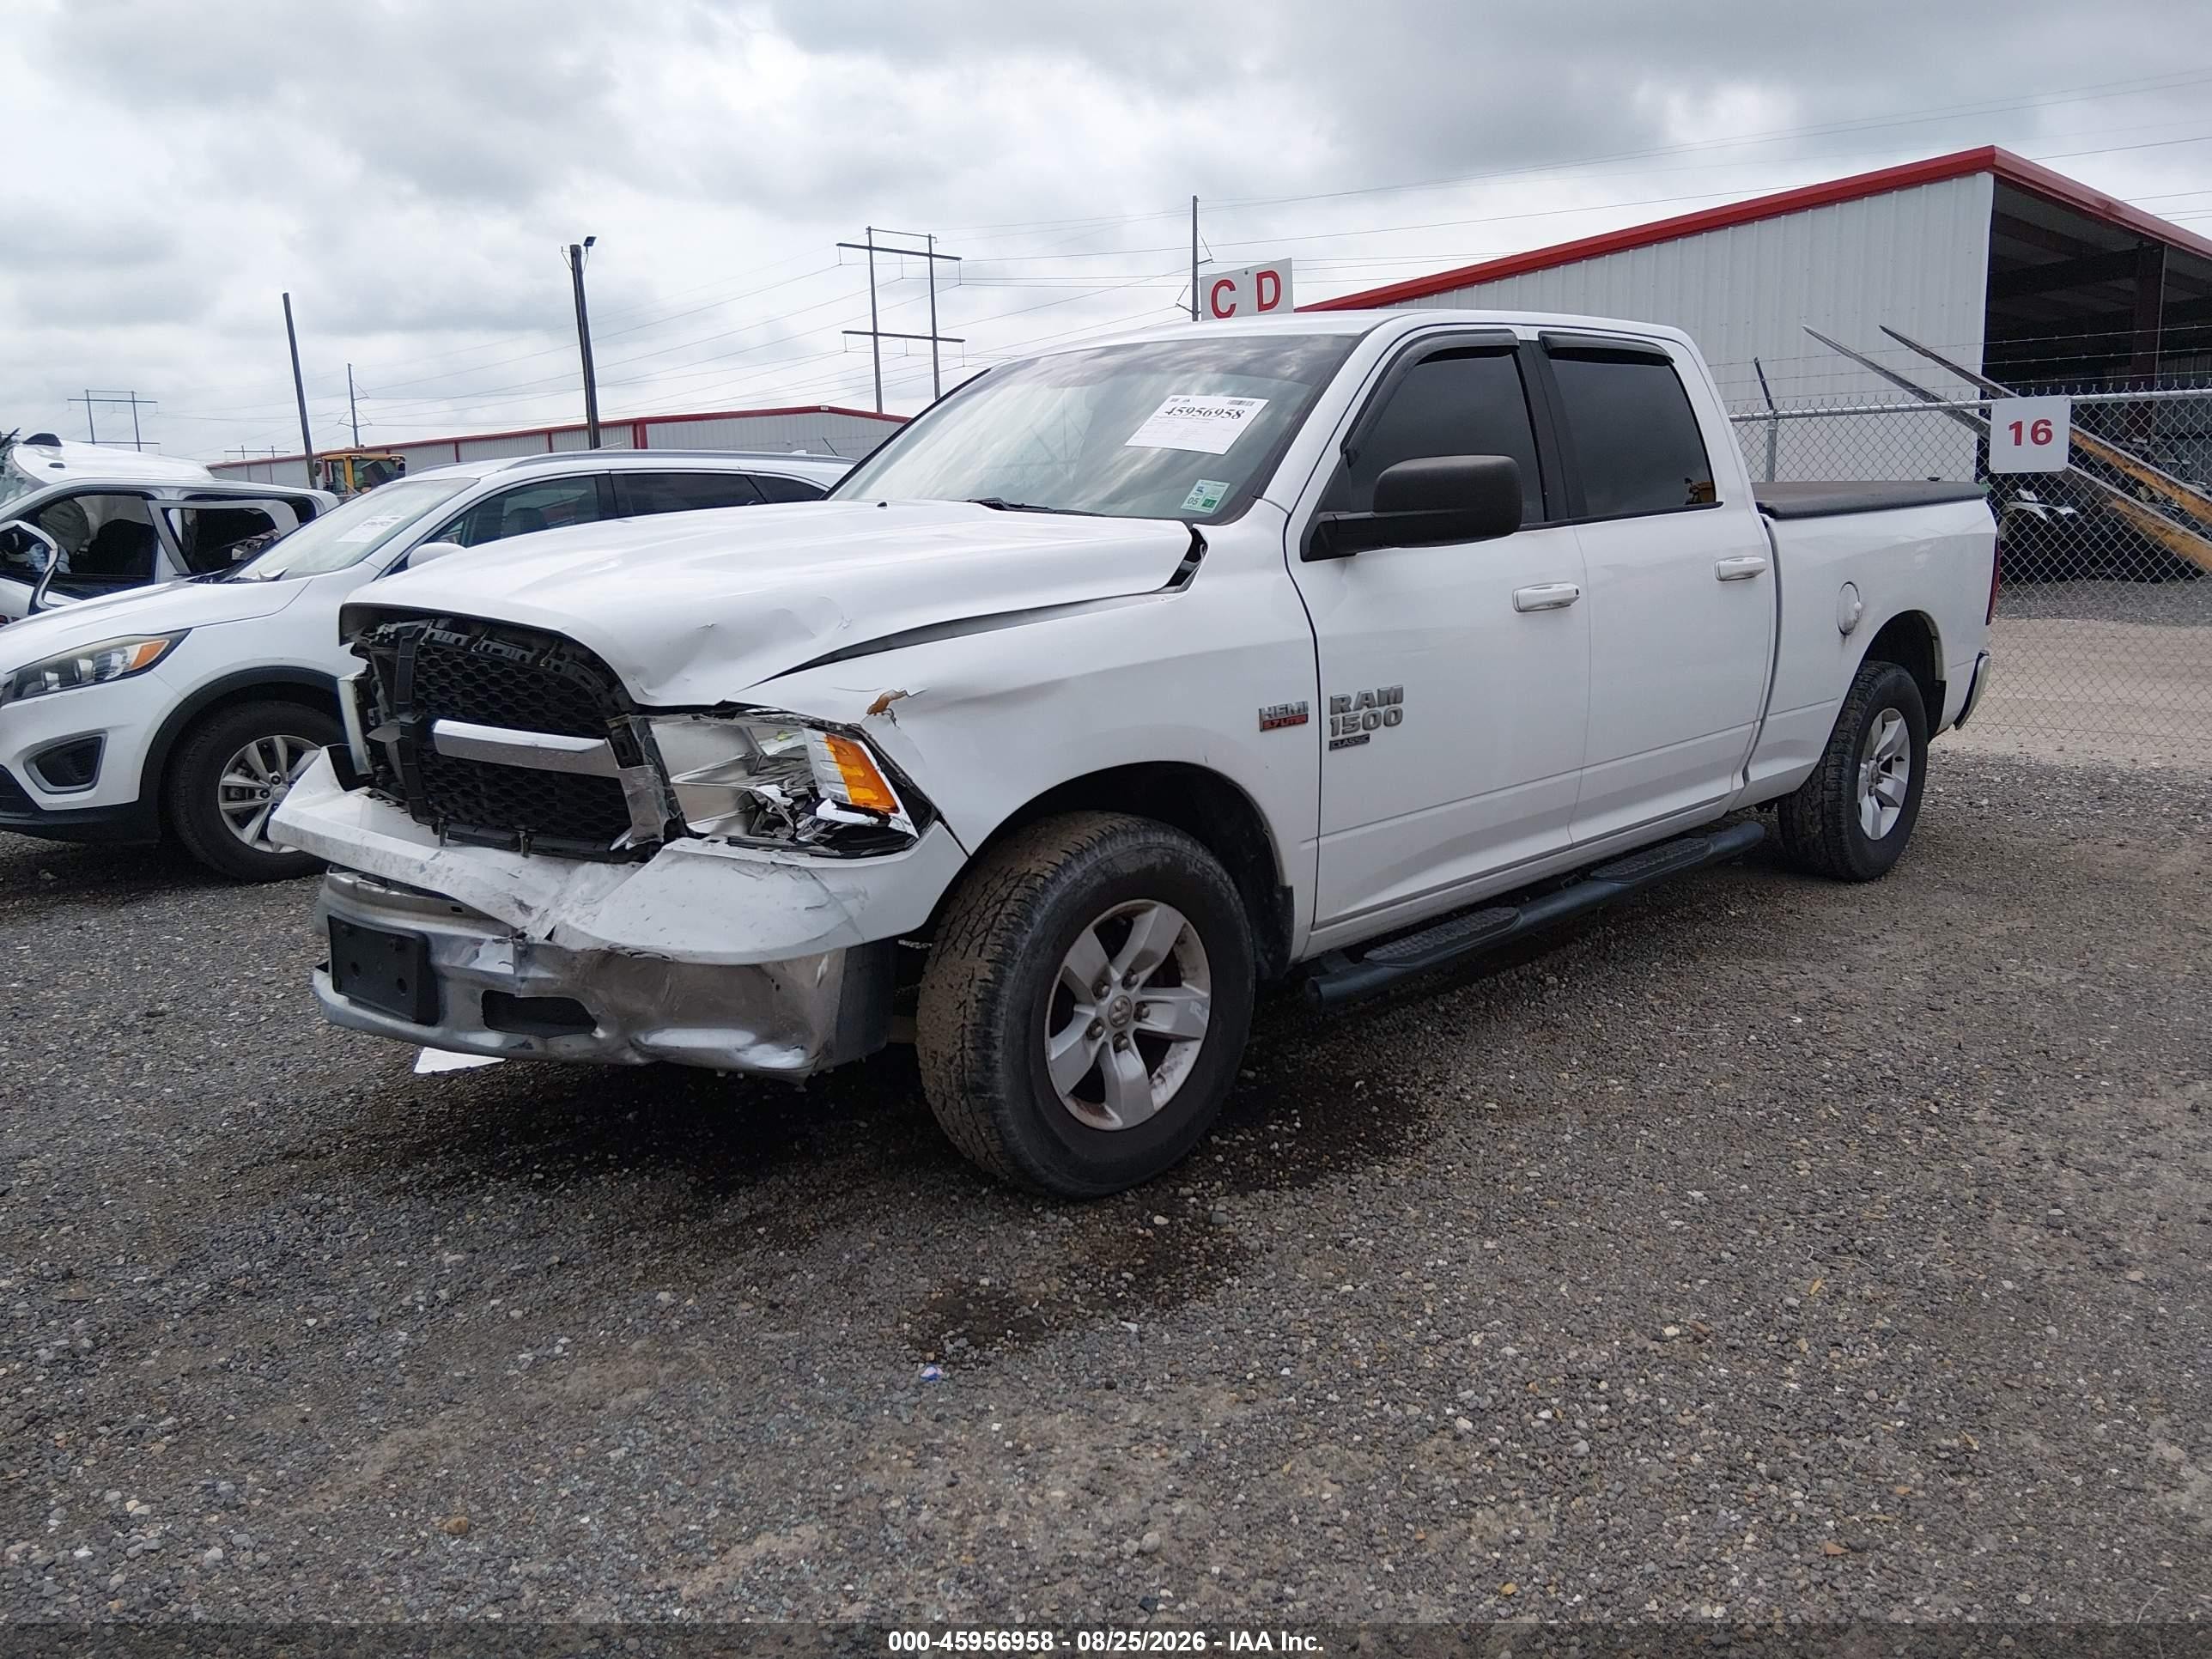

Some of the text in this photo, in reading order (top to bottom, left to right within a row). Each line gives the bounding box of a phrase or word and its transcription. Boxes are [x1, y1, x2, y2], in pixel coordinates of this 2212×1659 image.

[1211, 270, 1281, 319] C D
[1164, 406, 1245, 420] 45956958
[2008, 418, 2053, 447] 16
[1259, 701, 1309, 719] HEMI
[1330, 684, 1404, 715] RAM
[1329, 706, 1404, 737] 1500
[1331, 734, 1370, 749] CLASSIC
